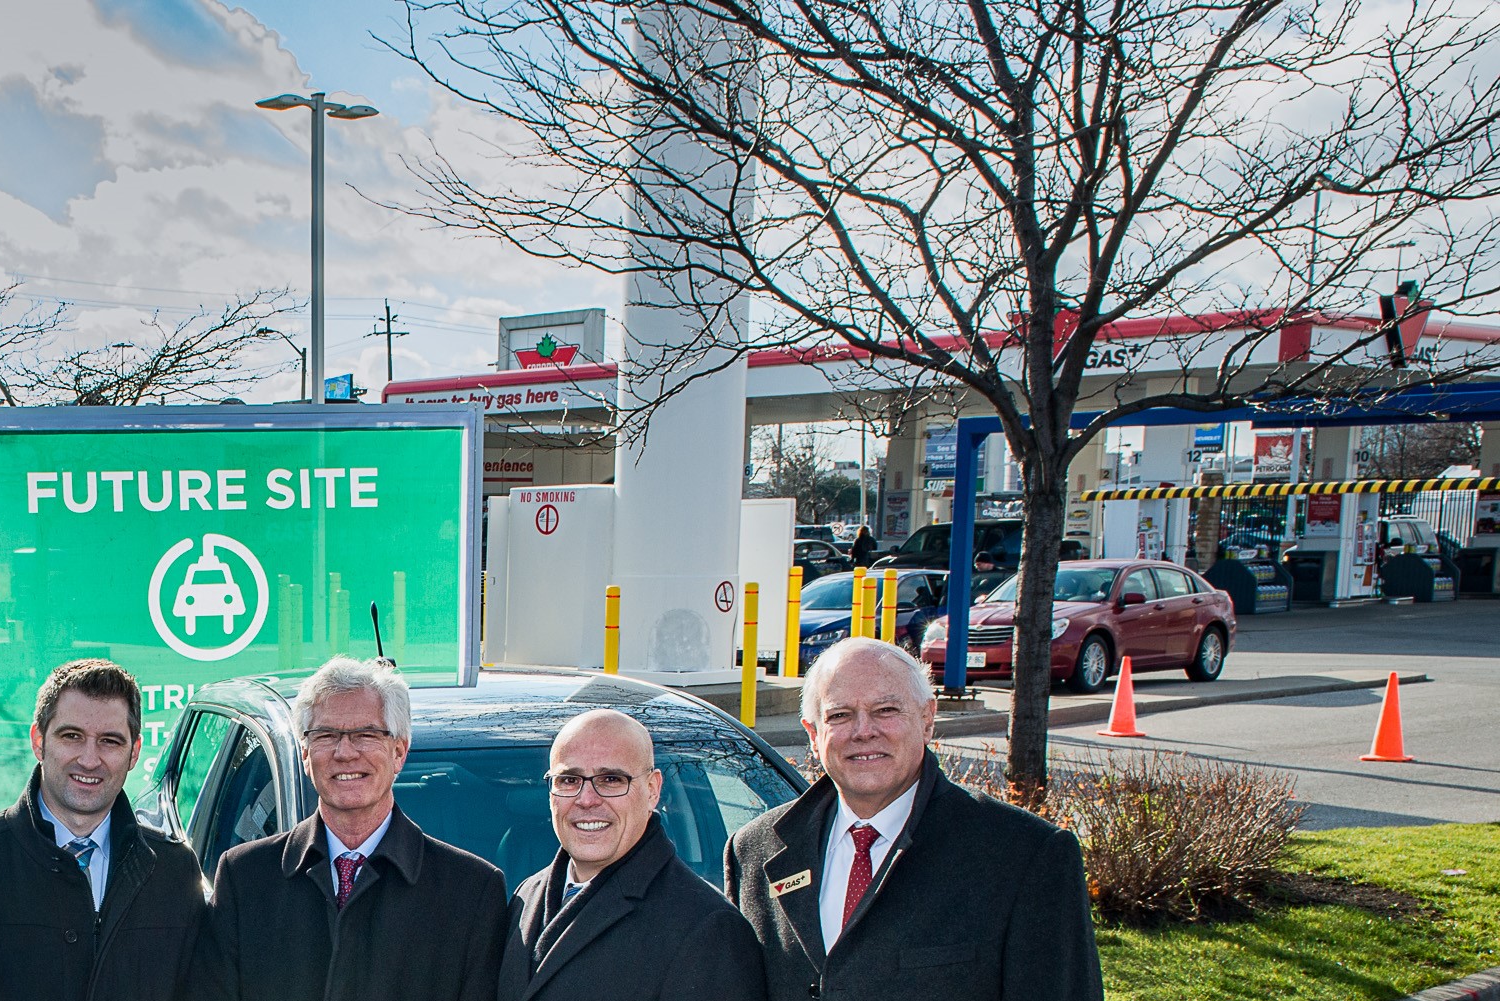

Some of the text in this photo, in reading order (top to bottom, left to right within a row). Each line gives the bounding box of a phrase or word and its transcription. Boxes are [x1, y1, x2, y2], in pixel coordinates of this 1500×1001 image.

[497, 393, 522, 410] gas
[525, 388, 559, 404] here
[1187, 450, 1202, 463] 12
[1355, 450, 1369, 463] 10
[483, 458, 533, 473] enience
[744, 466, 751, 477] 6
[1103, 470, 1110, 479] 2
[27, 467, 379, 514] FUTURE SITE
[520, 491, 576, 503] NO SMOKING
[784, 875, 805, 889] GAS+
